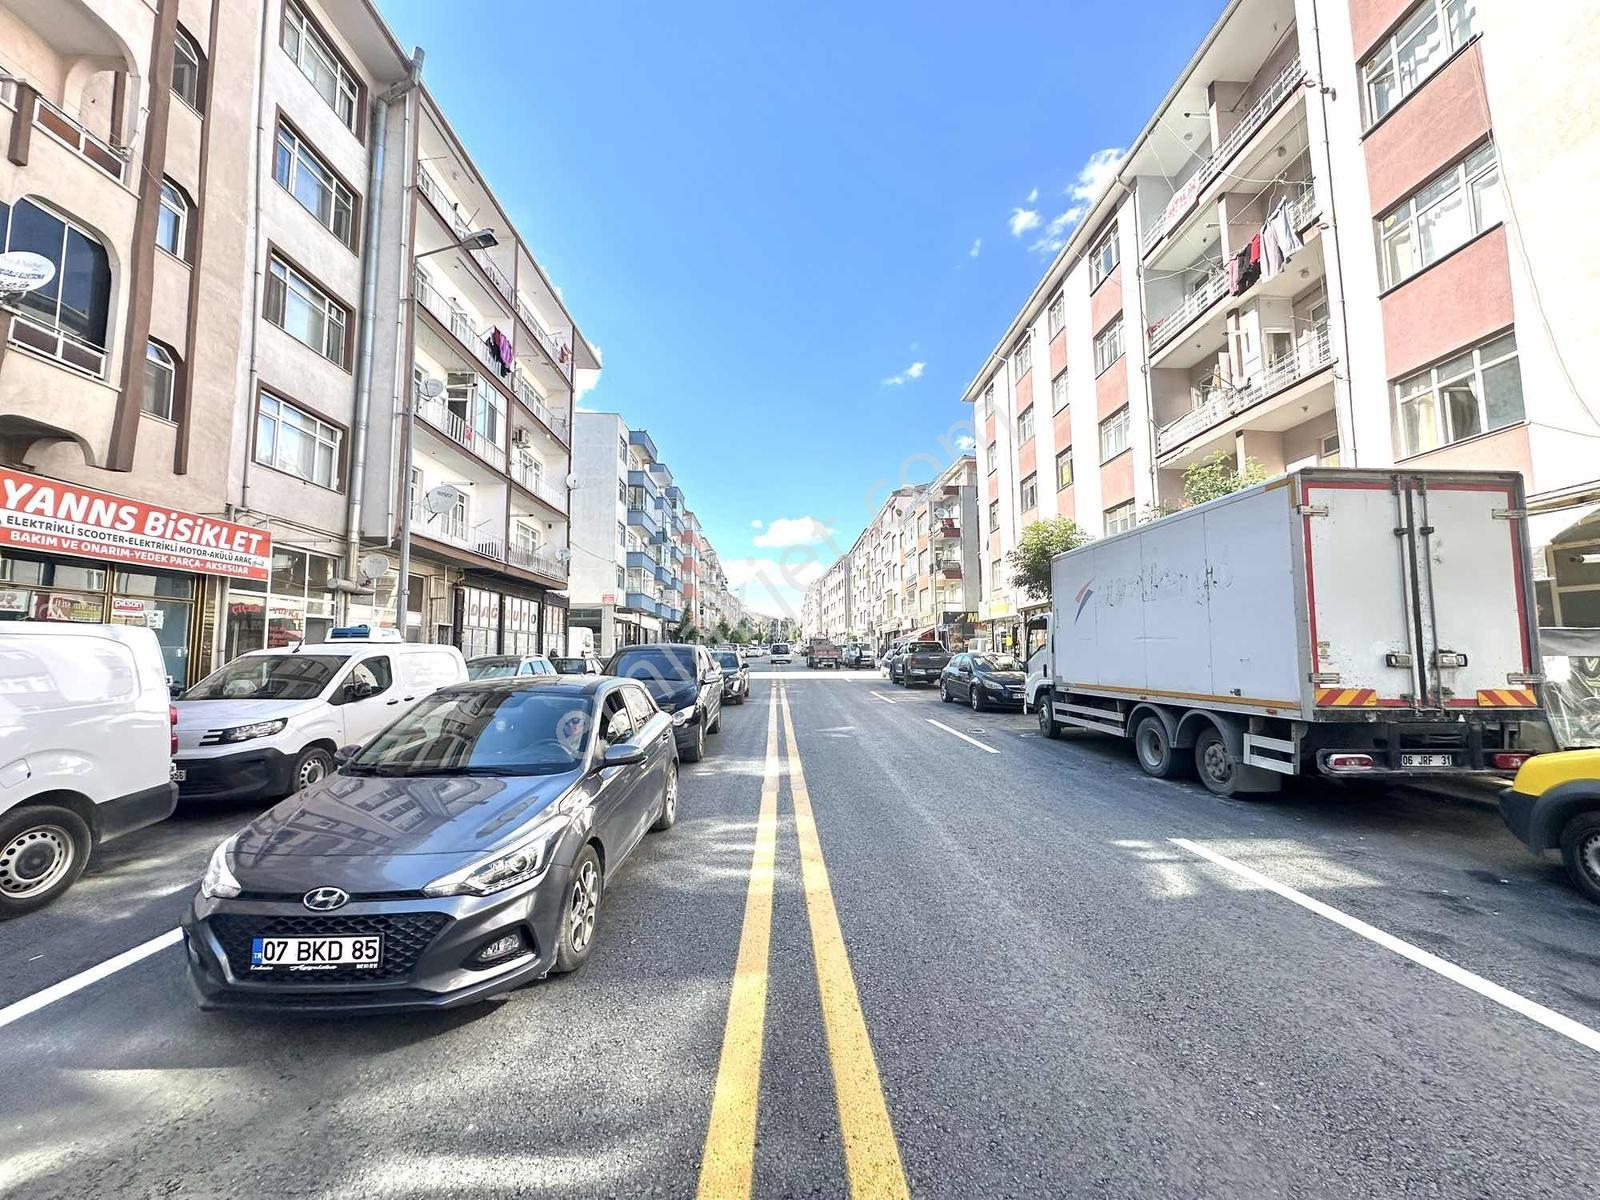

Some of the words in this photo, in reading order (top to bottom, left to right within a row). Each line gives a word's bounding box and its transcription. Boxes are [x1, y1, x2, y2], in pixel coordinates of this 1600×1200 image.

[3, 478, 139, 532] YANNS
[6, 515, 75, 535] ELEKTRİKLİ
[10, 530, 58, 547] BAKIM
[60, 538, 79, 550] VE
[206, 561, 249, 575] AKSESUAR
[1402, 755, 1413, 765] 06
[1441, 755, 1451, 765] 31
[264, 940, 289, 962] 07
[297, 940, 343, 962] BKD
[352, 939, 378, 961] 85
